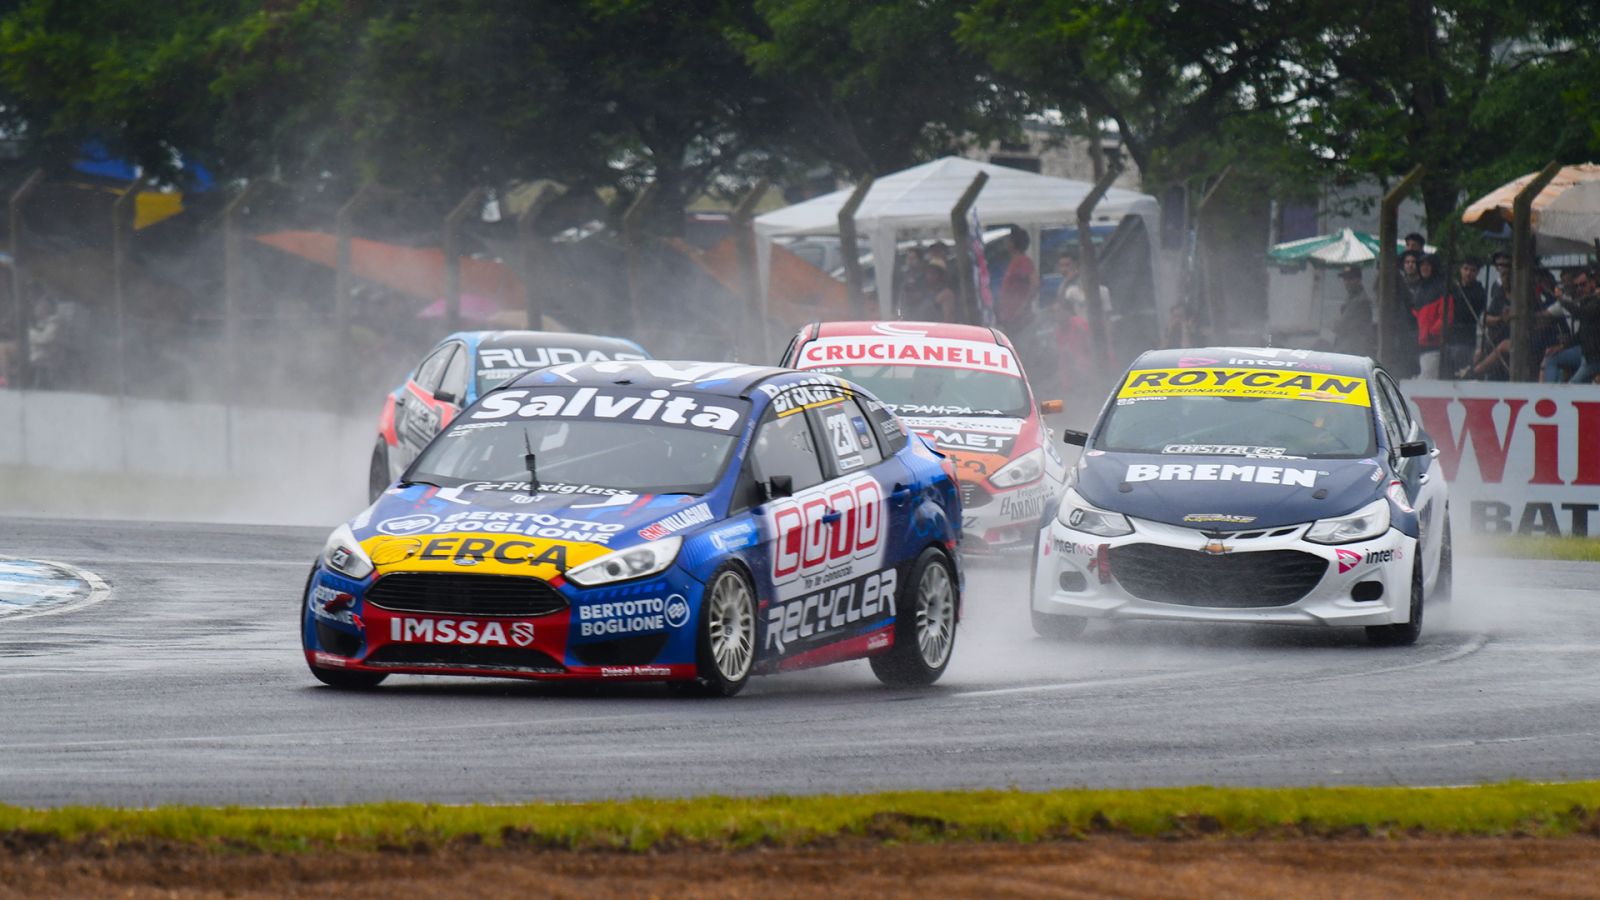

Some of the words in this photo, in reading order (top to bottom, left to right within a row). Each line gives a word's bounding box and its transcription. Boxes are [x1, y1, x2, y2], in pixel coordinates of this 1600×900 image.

[806, 344, 1009, 369] CRUCIANELLI
[1129, 370, 1362, 394] ROYCAN
[471, 387, 740, 432] Salvita
[1124, 463, 1318, 488] BREMEN
[433, 520, 614, 545] BOGLIONE
[444, 510, 625, 533] BERTOTTO
[774, 480, 881, 578] COTO
[579, 598, 664, 620] BERTOTTO
[390, 617, 508, 646] IMSSA
[580, 616, 665, 637] BOGLIONE
